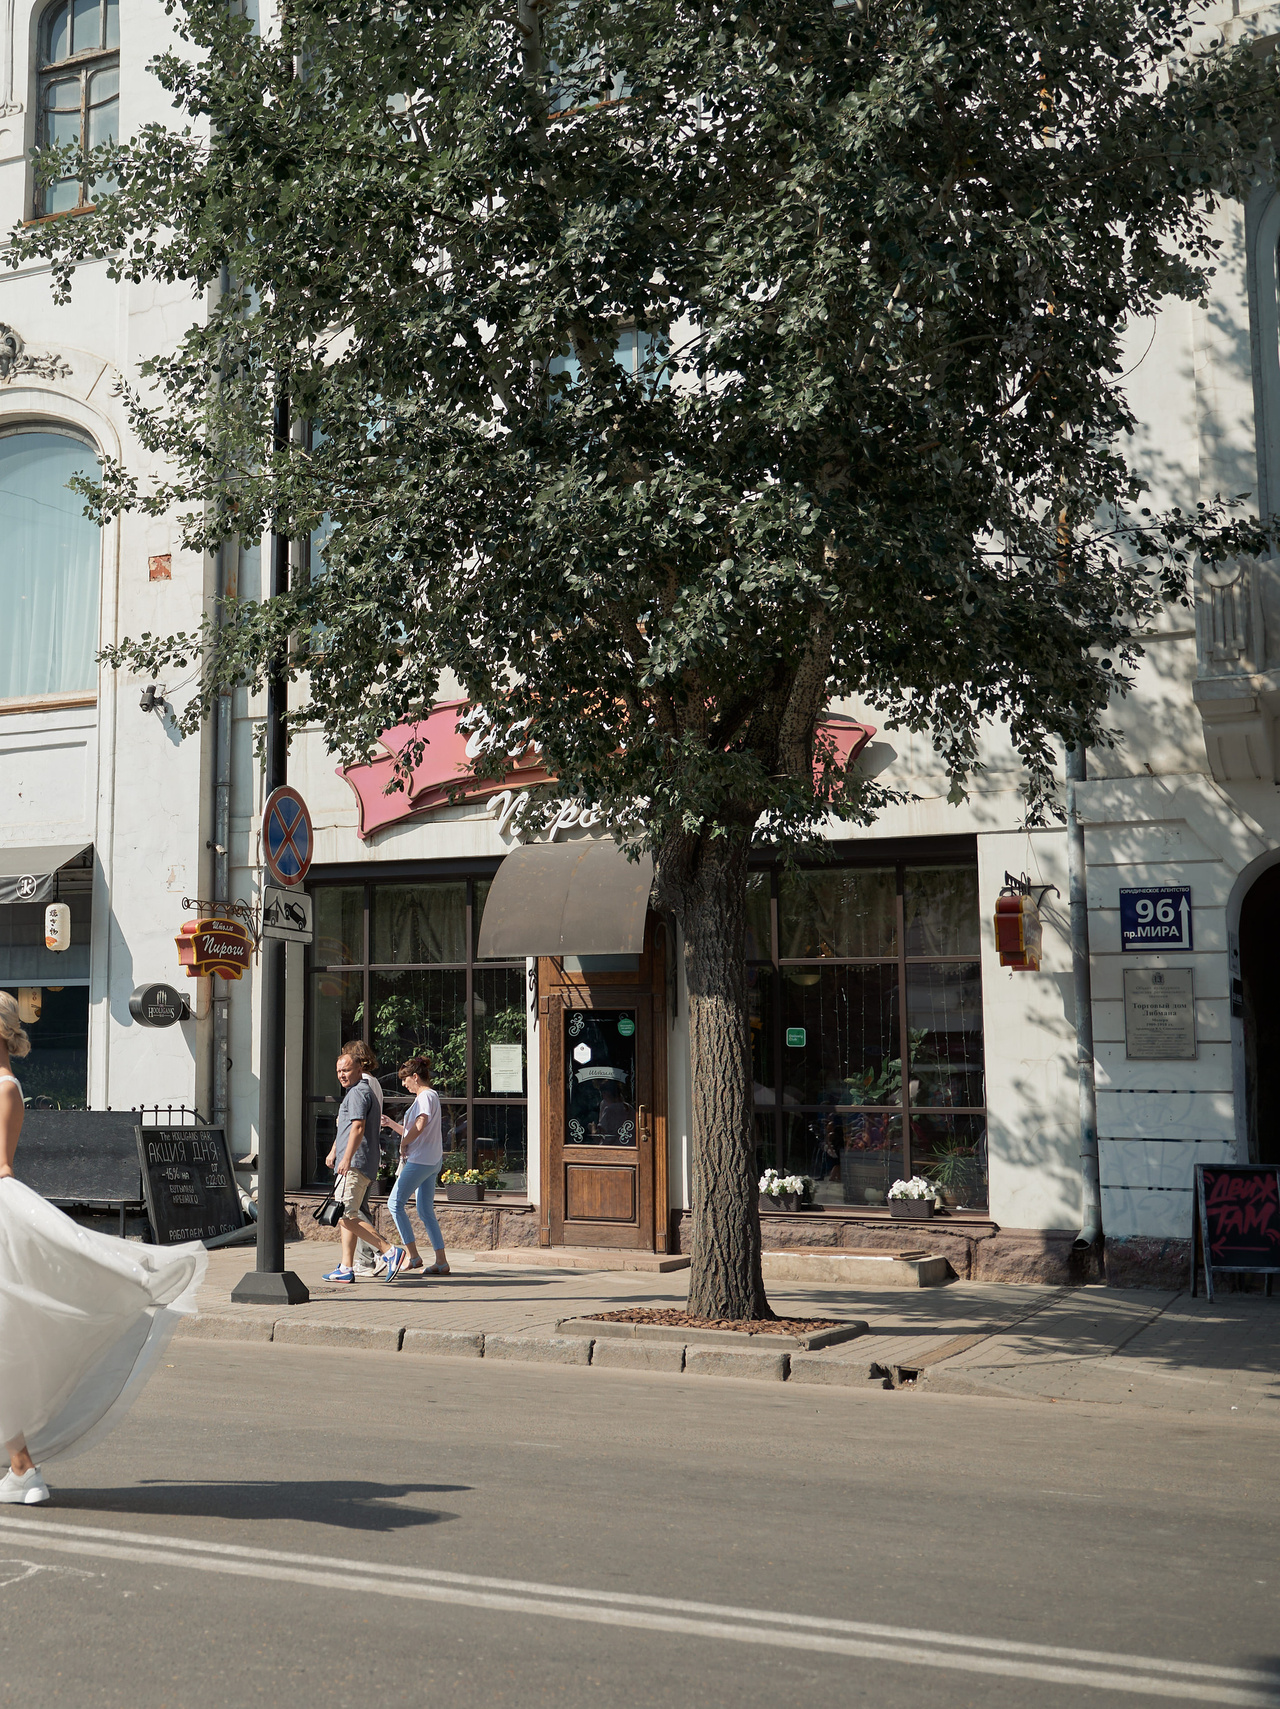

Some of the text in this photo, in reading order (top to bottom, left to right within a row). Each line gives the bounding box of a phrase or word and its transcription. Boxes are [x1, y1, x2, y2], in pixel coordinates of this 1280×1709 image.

[1135, 898, 1175, 923] 96
[202, 934, 245, 958] Пироги
[148, 1007, 175, 1019] HOOLIGANS
[159, 1132, 171, 1141] The
[172, 1131, 199, 1141] HOOLIGANS
[148, 1141, 187, 1163] АКЦИЯ
[161, 1167, 180, 1180] -15%
[1207, 1202, 1276, 1236] ТАМ
[169, 1227, 204, 1241] РАБОТАЕМ
